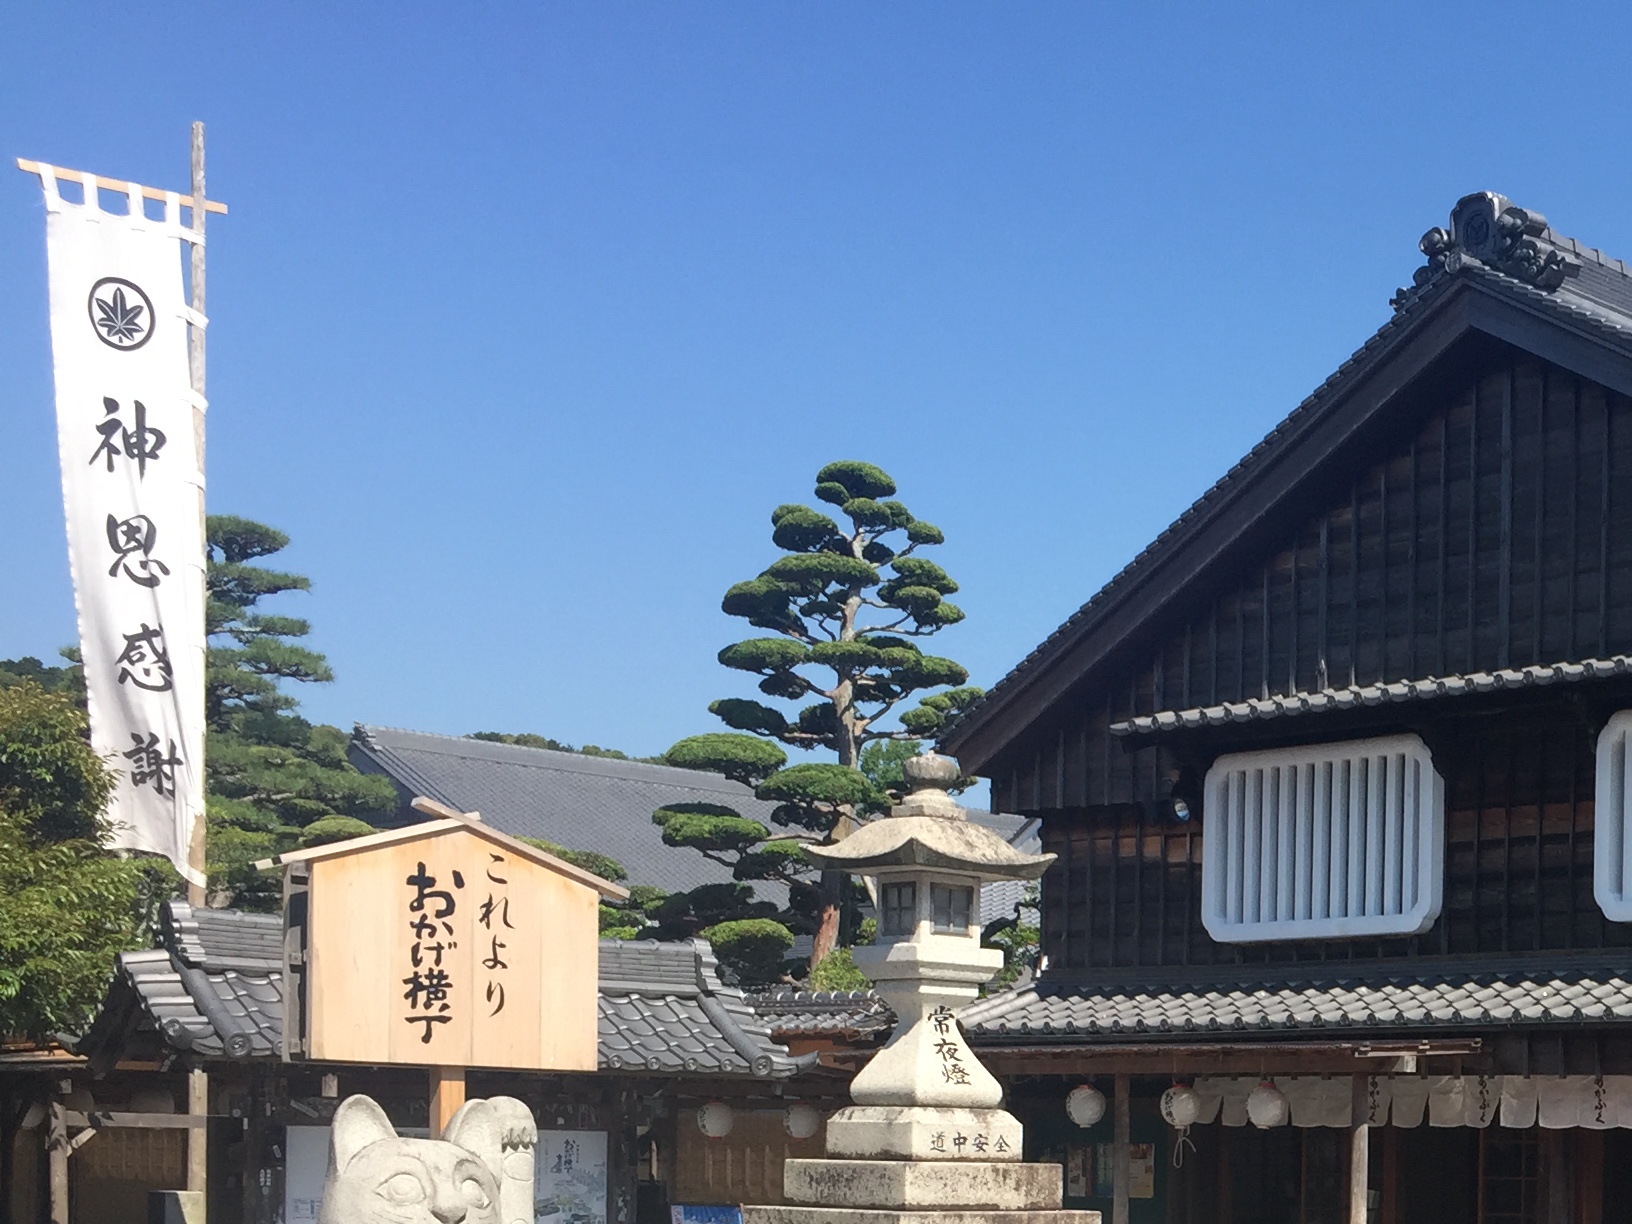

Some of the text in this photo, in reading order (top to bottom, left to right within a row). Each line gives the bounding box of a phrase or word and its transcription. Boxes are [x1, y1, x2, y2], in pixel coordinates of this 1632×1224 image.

[89, 396, 183, 797] 神恩感謝
[402, 862, 465, 1045] おかげ横丁
[478, 853, 516, 1018] これより
[926, 1005, 972, 1086] 常夜燈
[930, 1131, 1012, 1154] 道中安全
